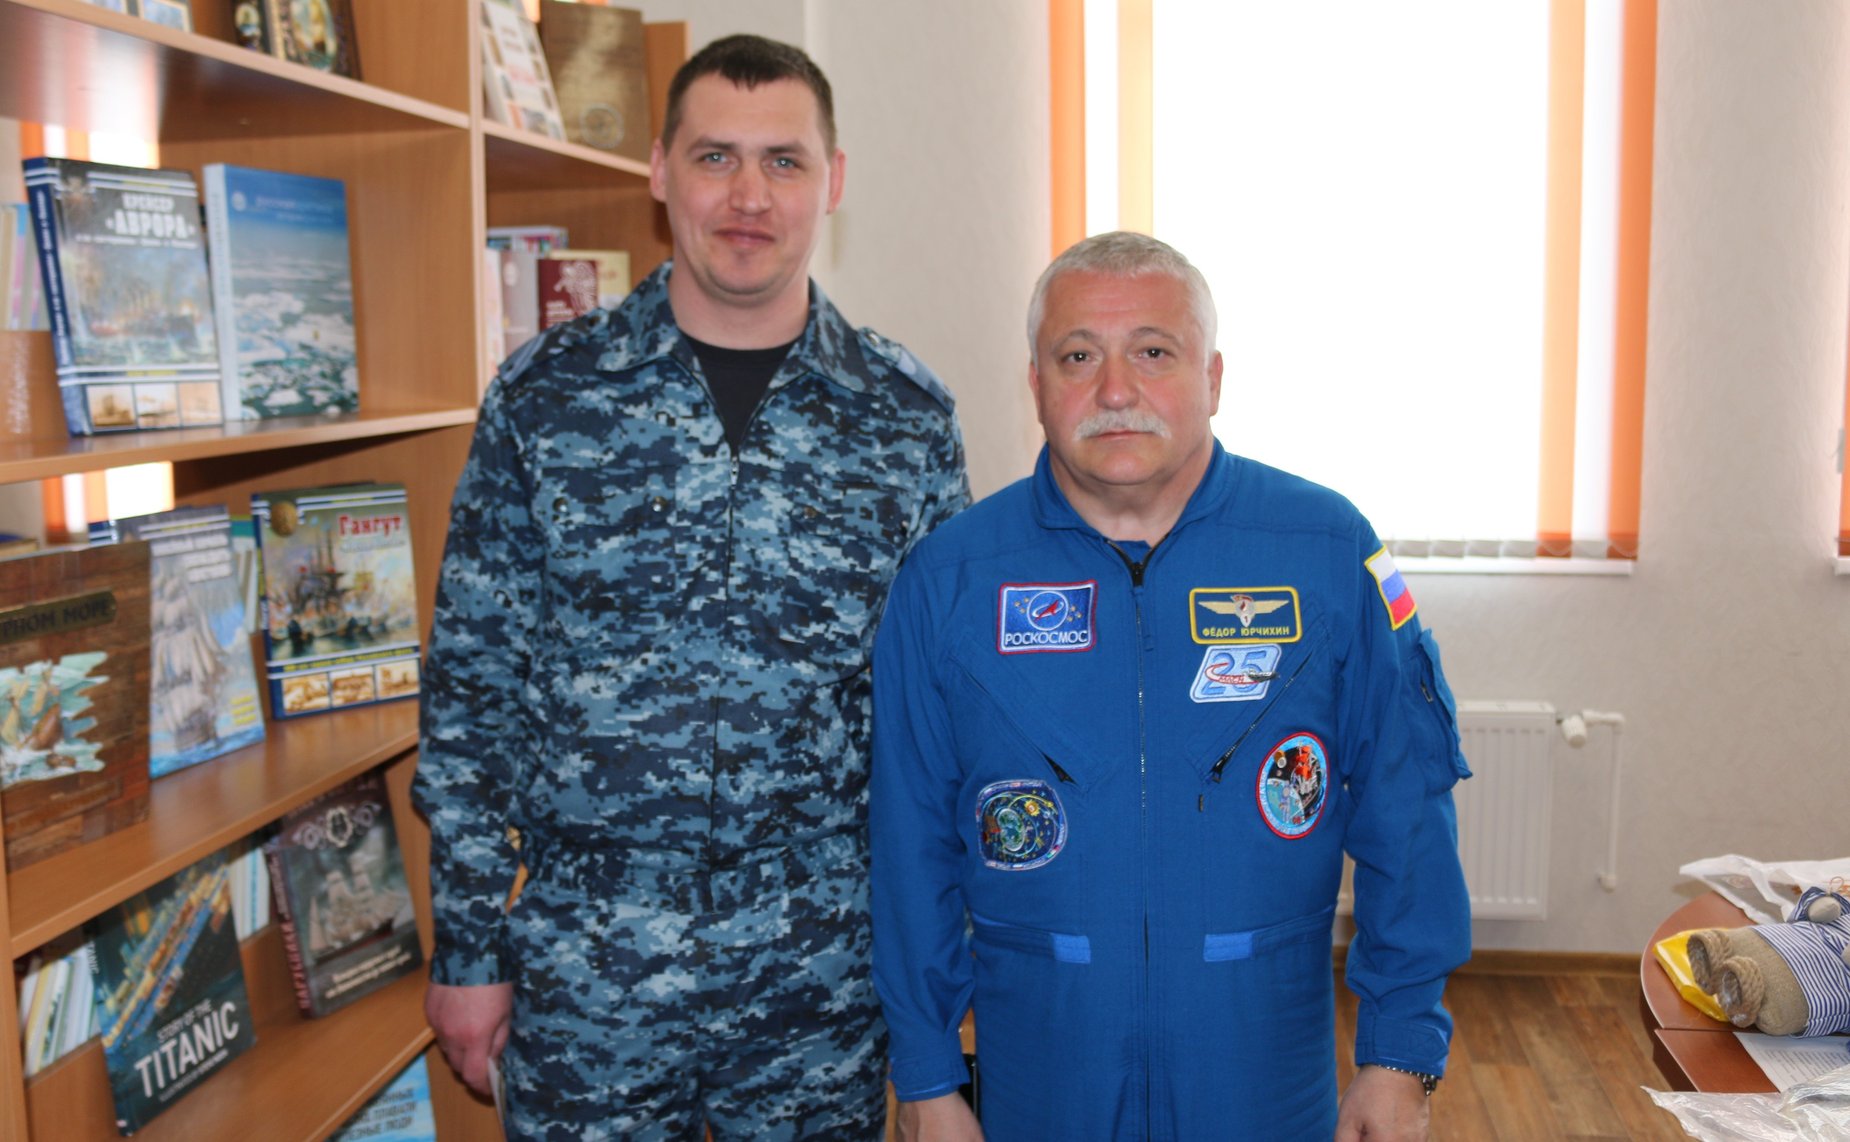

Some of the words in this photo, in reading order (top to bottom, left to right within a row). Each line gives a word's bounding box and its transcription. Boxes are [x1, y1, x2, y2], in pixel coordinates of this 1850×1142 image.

[339, 514, 402, 538] Гангут
[0, 610, 56, 638] РНОМ
[1241, 626, 1290, 637] ЮРЧИХИН
[1005, 630, 1088, 646] РОСКОСМОС
[157, 1017, 184, 1043] STORY
[133, 1001, 240, 1099] TITANIC
